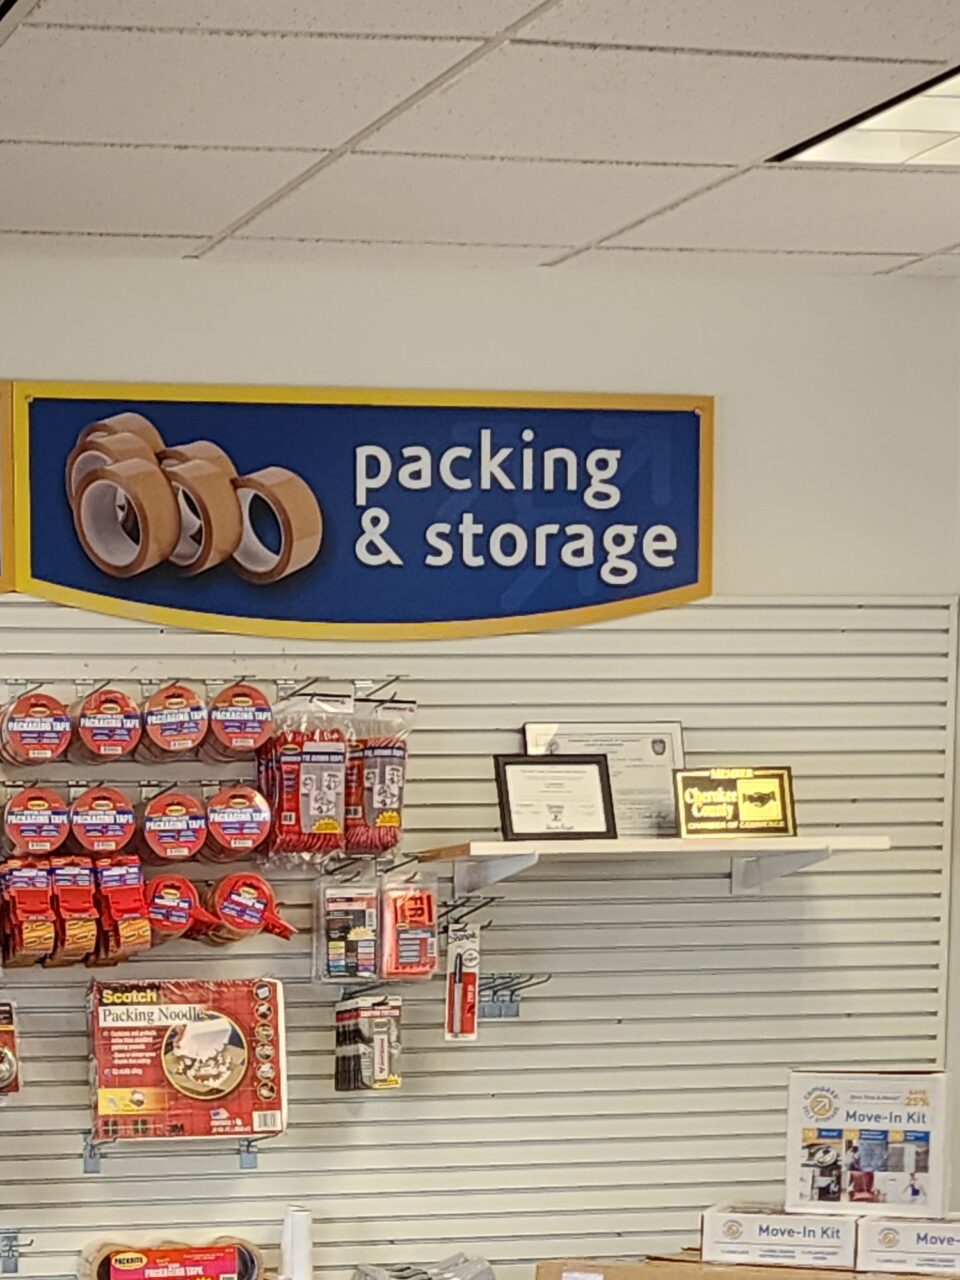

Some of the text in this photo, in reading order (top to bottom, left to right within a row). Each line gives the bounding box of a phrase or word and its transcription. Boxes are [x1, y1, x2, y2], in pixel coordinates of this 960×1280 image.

[354, 429, 622, 510] packing
[355, 508, 678, 585] & storage
[212, 710, 272, 721] PACKAGING TAPE
[80, 718, 140, 729] PACKAGING TAPE
[684, 787, 738, 805] Cherokee
[8, 814, 68, 825] PACKAGING TAPE
[73, 814, 133, 824] PACKAGING TAPE
[146, 818, 206, 831] PACKAGING TAPE
[102, 990, 157, 1004] Scotch
[103, 1007, 154, 1024] Packing
[905, 1097, 930, 1107] 25%
[845, 1110, 926, 1124] Move-In Kit
[758, 1225, 840, 1239] Move-In Kit
